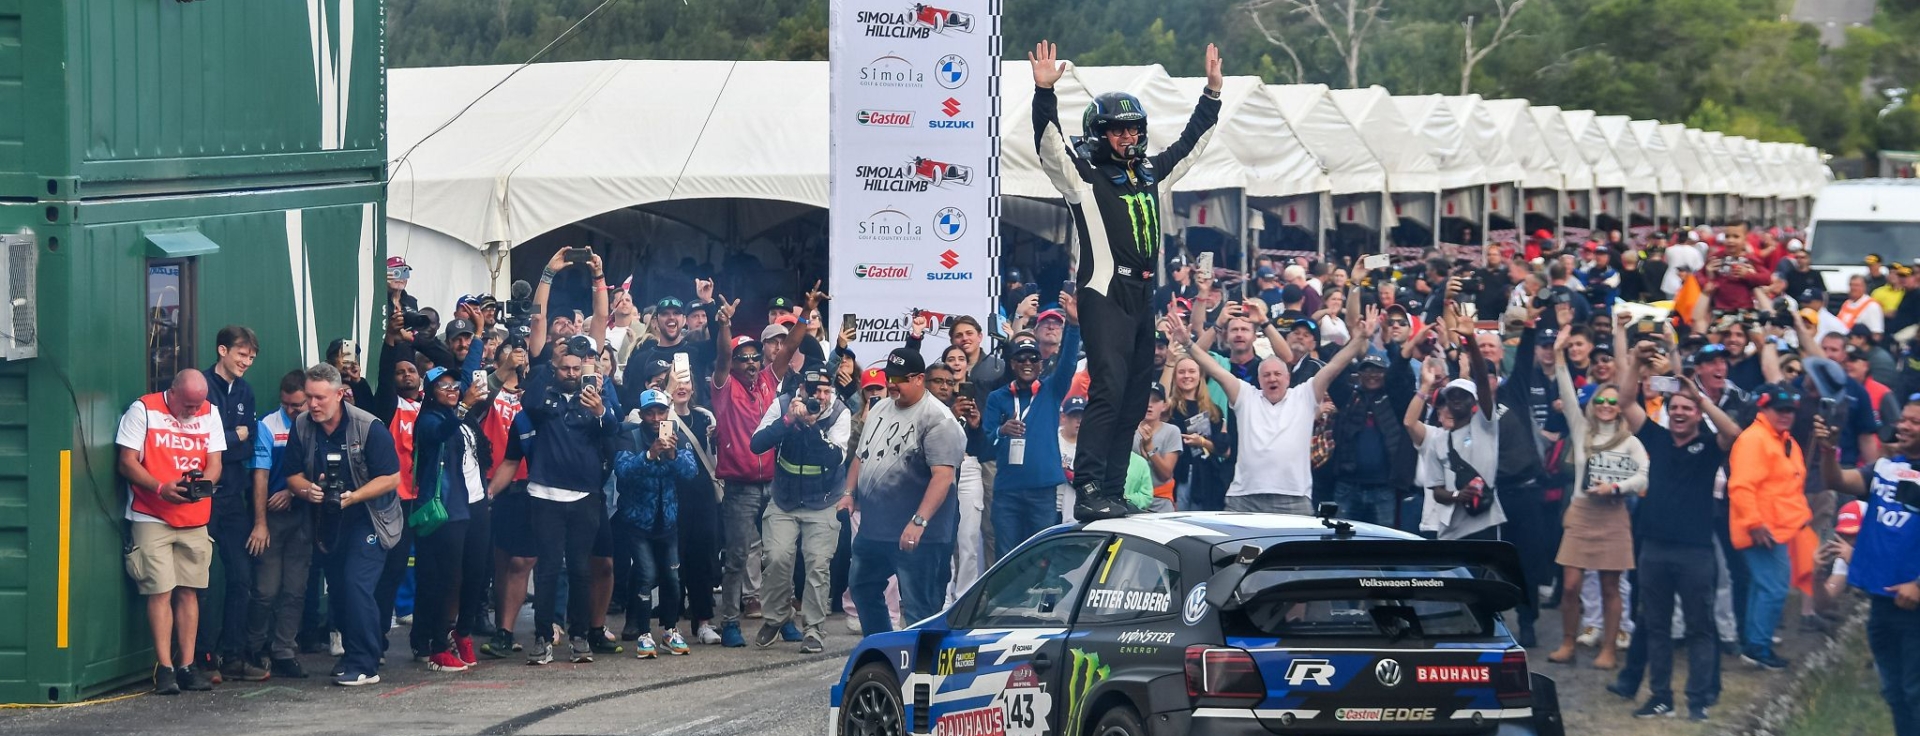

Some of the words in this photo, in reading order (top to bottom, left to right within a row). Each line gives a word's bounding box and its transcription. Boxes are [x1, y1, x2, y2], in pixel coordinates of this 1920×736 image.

[856, 11, 905, 25] SIMOLA
[865, 25, 930, 39] HILLCLIMB
[860, 67, 924, 82] Simola
[870, 112, 911, 125] Castrol
[929, 120, 974, 129] SUZUKI
[855, 166, 903, 179] SIMOLA
[863, 179, 929, 192] HILLCLIMB
[859, 221, 922, 235] Simola
[868, 265, 909, 278] Castrol
[927, 272, 973, 280] SUZUKI
[859, 331, 924, 343] HILLCLI
[155, 432, 211, 452] MEDIA
[1877, 505, 1911, 528] 107
[1099, 537, 1123, 584] 1
[1359, 578, 1410, 588] Volkswagen
[1411, 578, 1444, 587] Sweden
[1086, 589, 1122, 608] PETTER
[1124, 590, 1170, 612] SOLBERG
[1015, 644, 1033, 652] SCANIA
[1120, 646, 1159, 654] ENERGY
[900, 650, 909, 669] D
[1417, 667, 1491, 681] BAUHAUS
[1003, 694, 1035, 730] 143
[1344, 709, 1381, 720] Castrol
[1381, 708, 1437, 721] EDGE
[937, 707, 1003, 736] BAUHAUS
